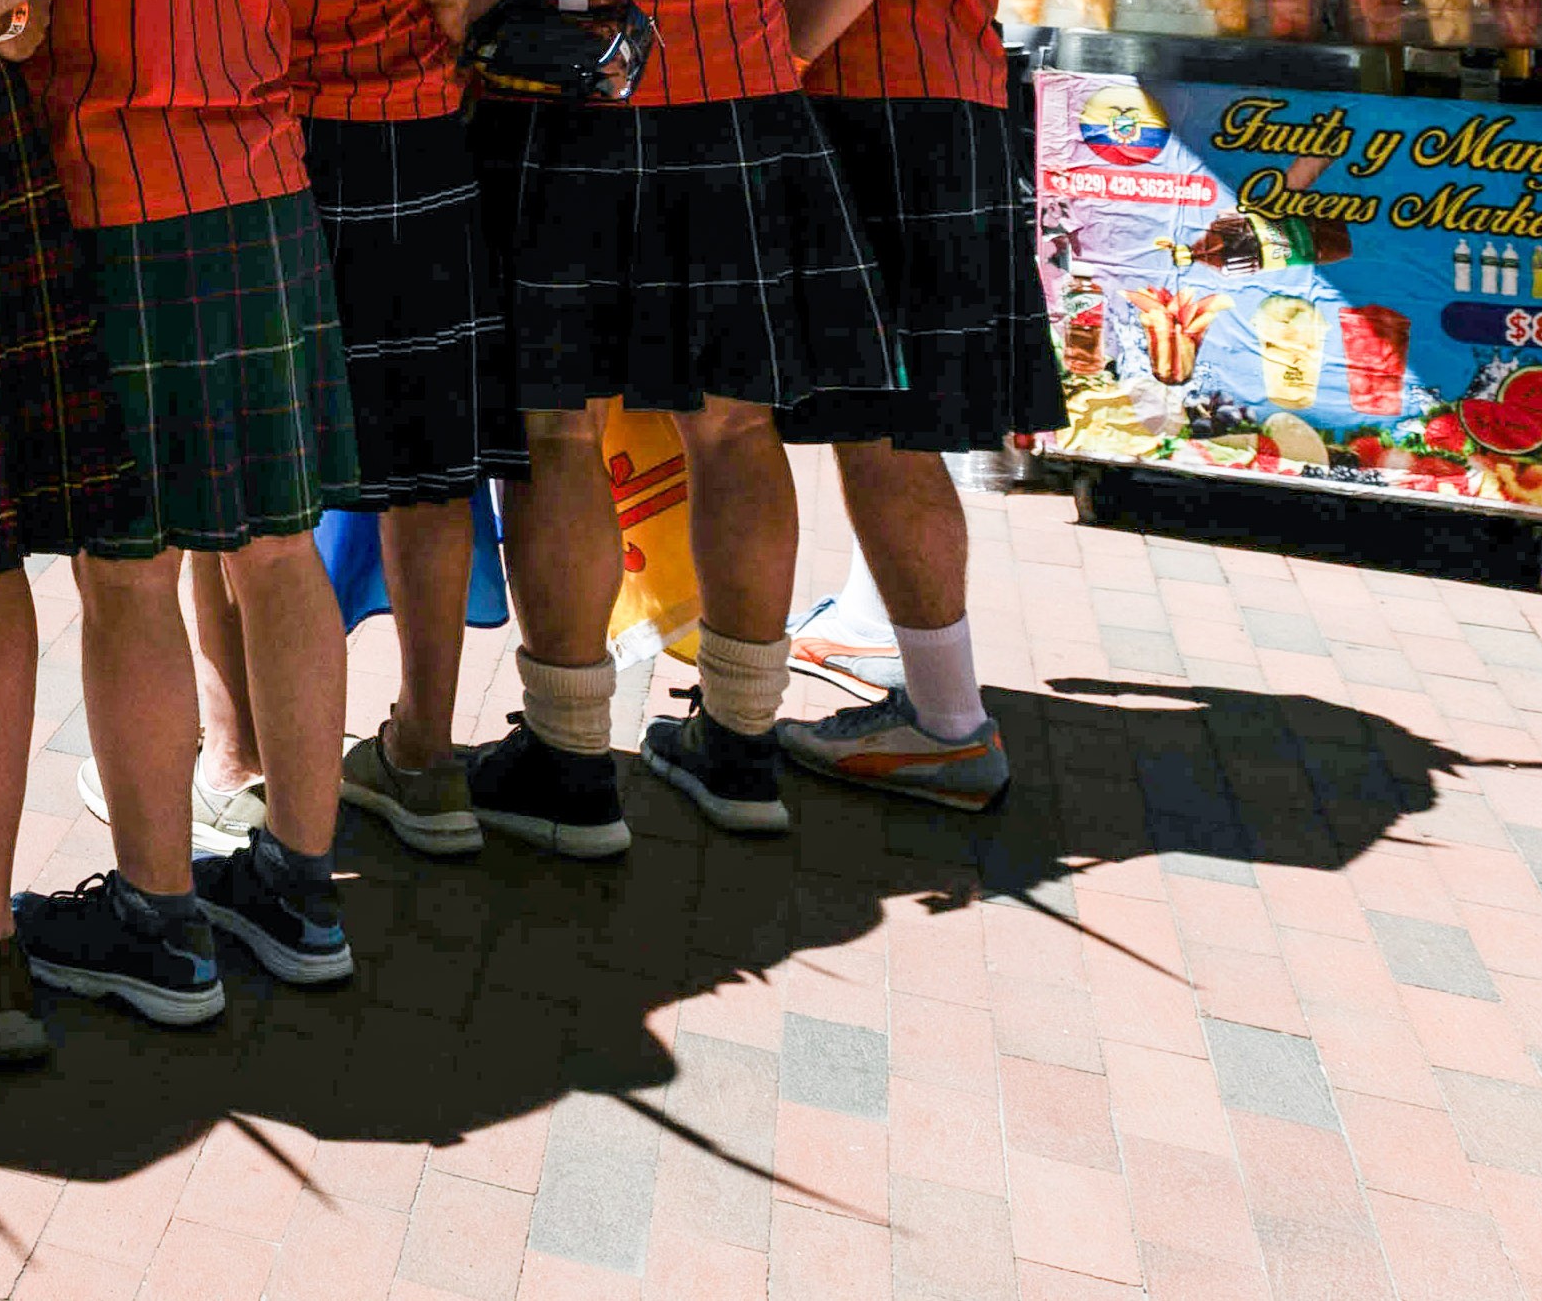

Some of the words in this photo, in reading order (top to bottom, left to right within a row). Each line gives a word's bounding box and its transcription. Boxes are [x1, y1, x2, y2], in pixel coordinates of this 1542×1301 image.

[1214, 97, 1353, 157] Fruits
[1349, 130, 1404, 176] y
[1413, 114, 1542, 191] Man
[1071, 172, 1106, 197] (929)
[1108, 176, 1174, 196] 420-3623
[1174, 183, 1212, 201] zelle
[1237, 168, 1380, 223] Queens
